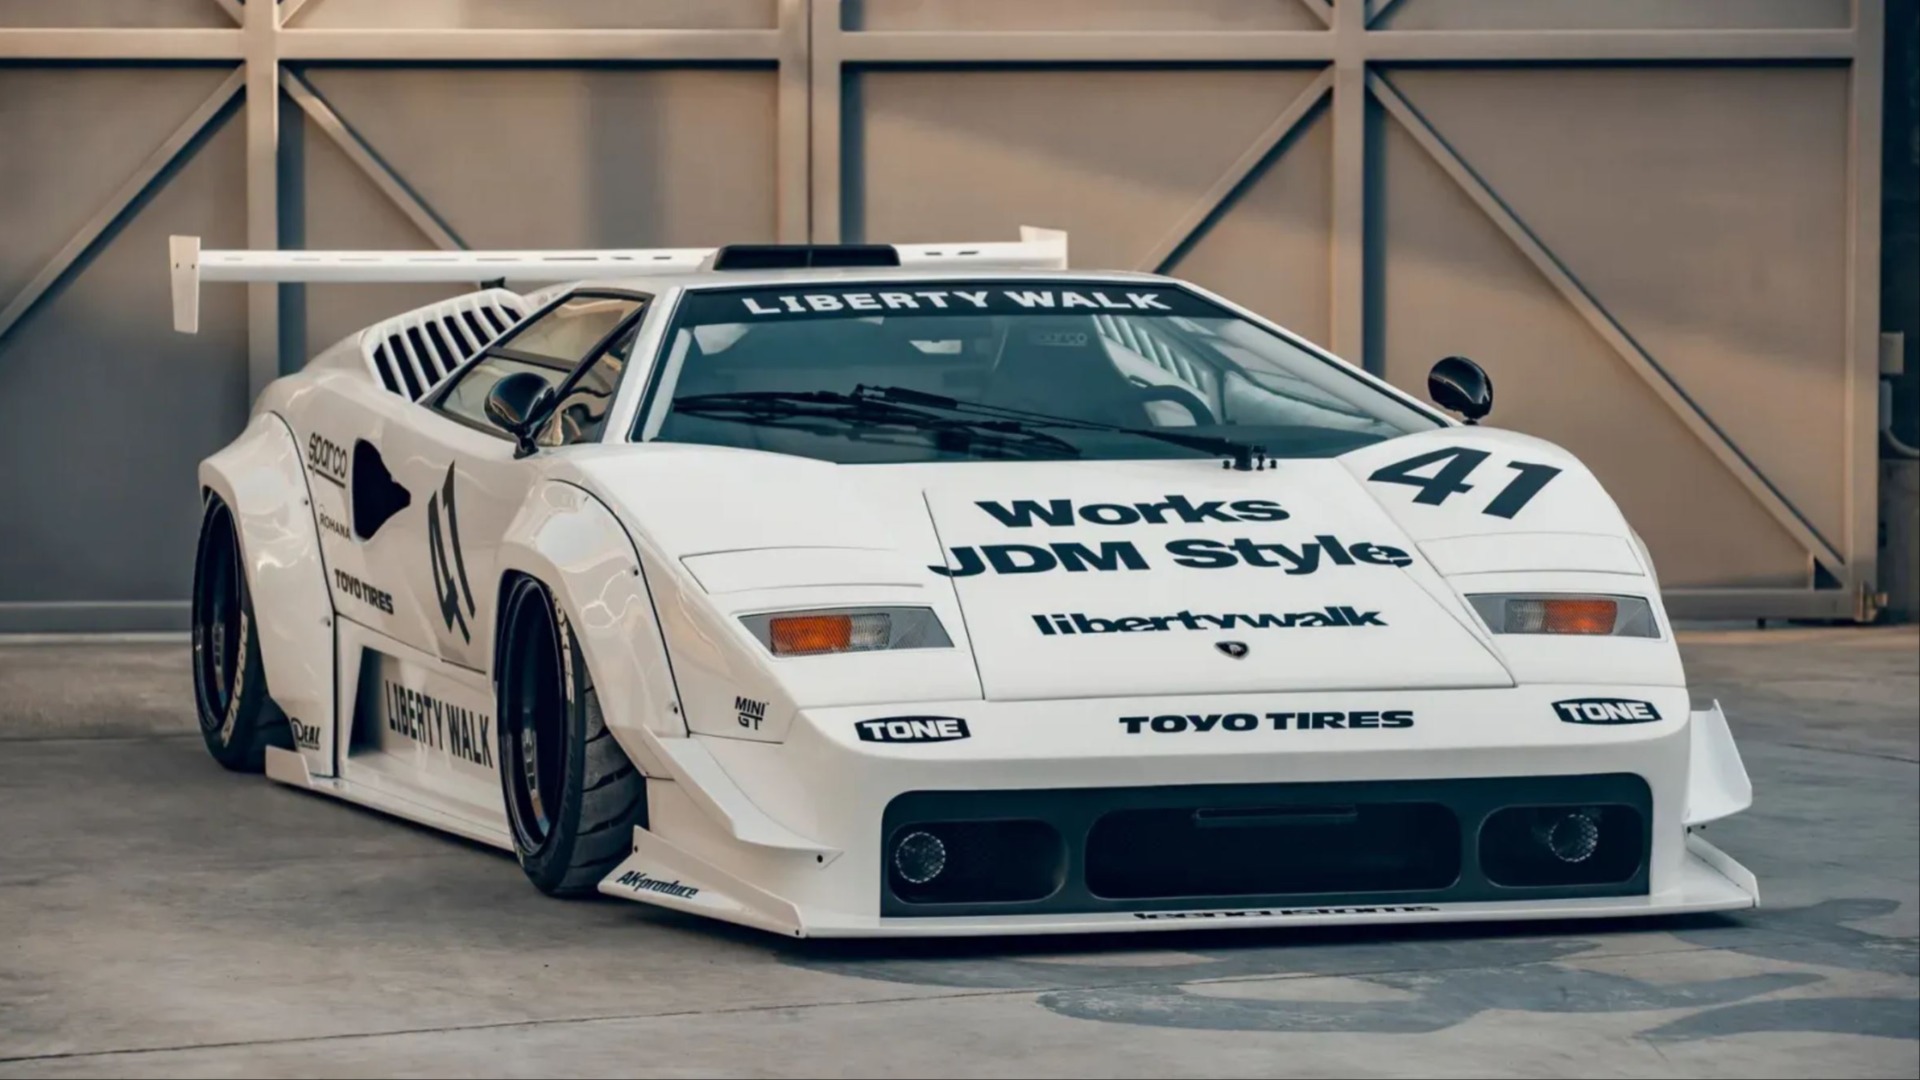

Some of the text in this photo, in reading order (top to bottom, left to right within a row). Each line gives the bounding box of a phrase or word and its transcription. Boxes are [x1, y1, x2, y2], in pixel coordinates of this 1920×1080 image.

[741, 291, 1173, 315] LIBERTY WALK
[308, 432, 348, 479] sparco
[1367, 446, 1562, 519] 41
[974, 494, 1290, 528] Works
[428, 459, 476, 646] 41
[927, 535, 1414, 578] JDM Style
[334, 568, 394, 615] TOYO TIRES
[1032, 606, 1388, 636] libertywalk
[735, 696, 766, 717] MINI
[738, 712, 763, 731] GT
[1119, 710, 1414, 734] TOYO TIRES
[1559, 702, 1655, 721] TONE
[385, 680, 493, 769] LIBERTY WALK
[863, 719, 962, 739] TONE
